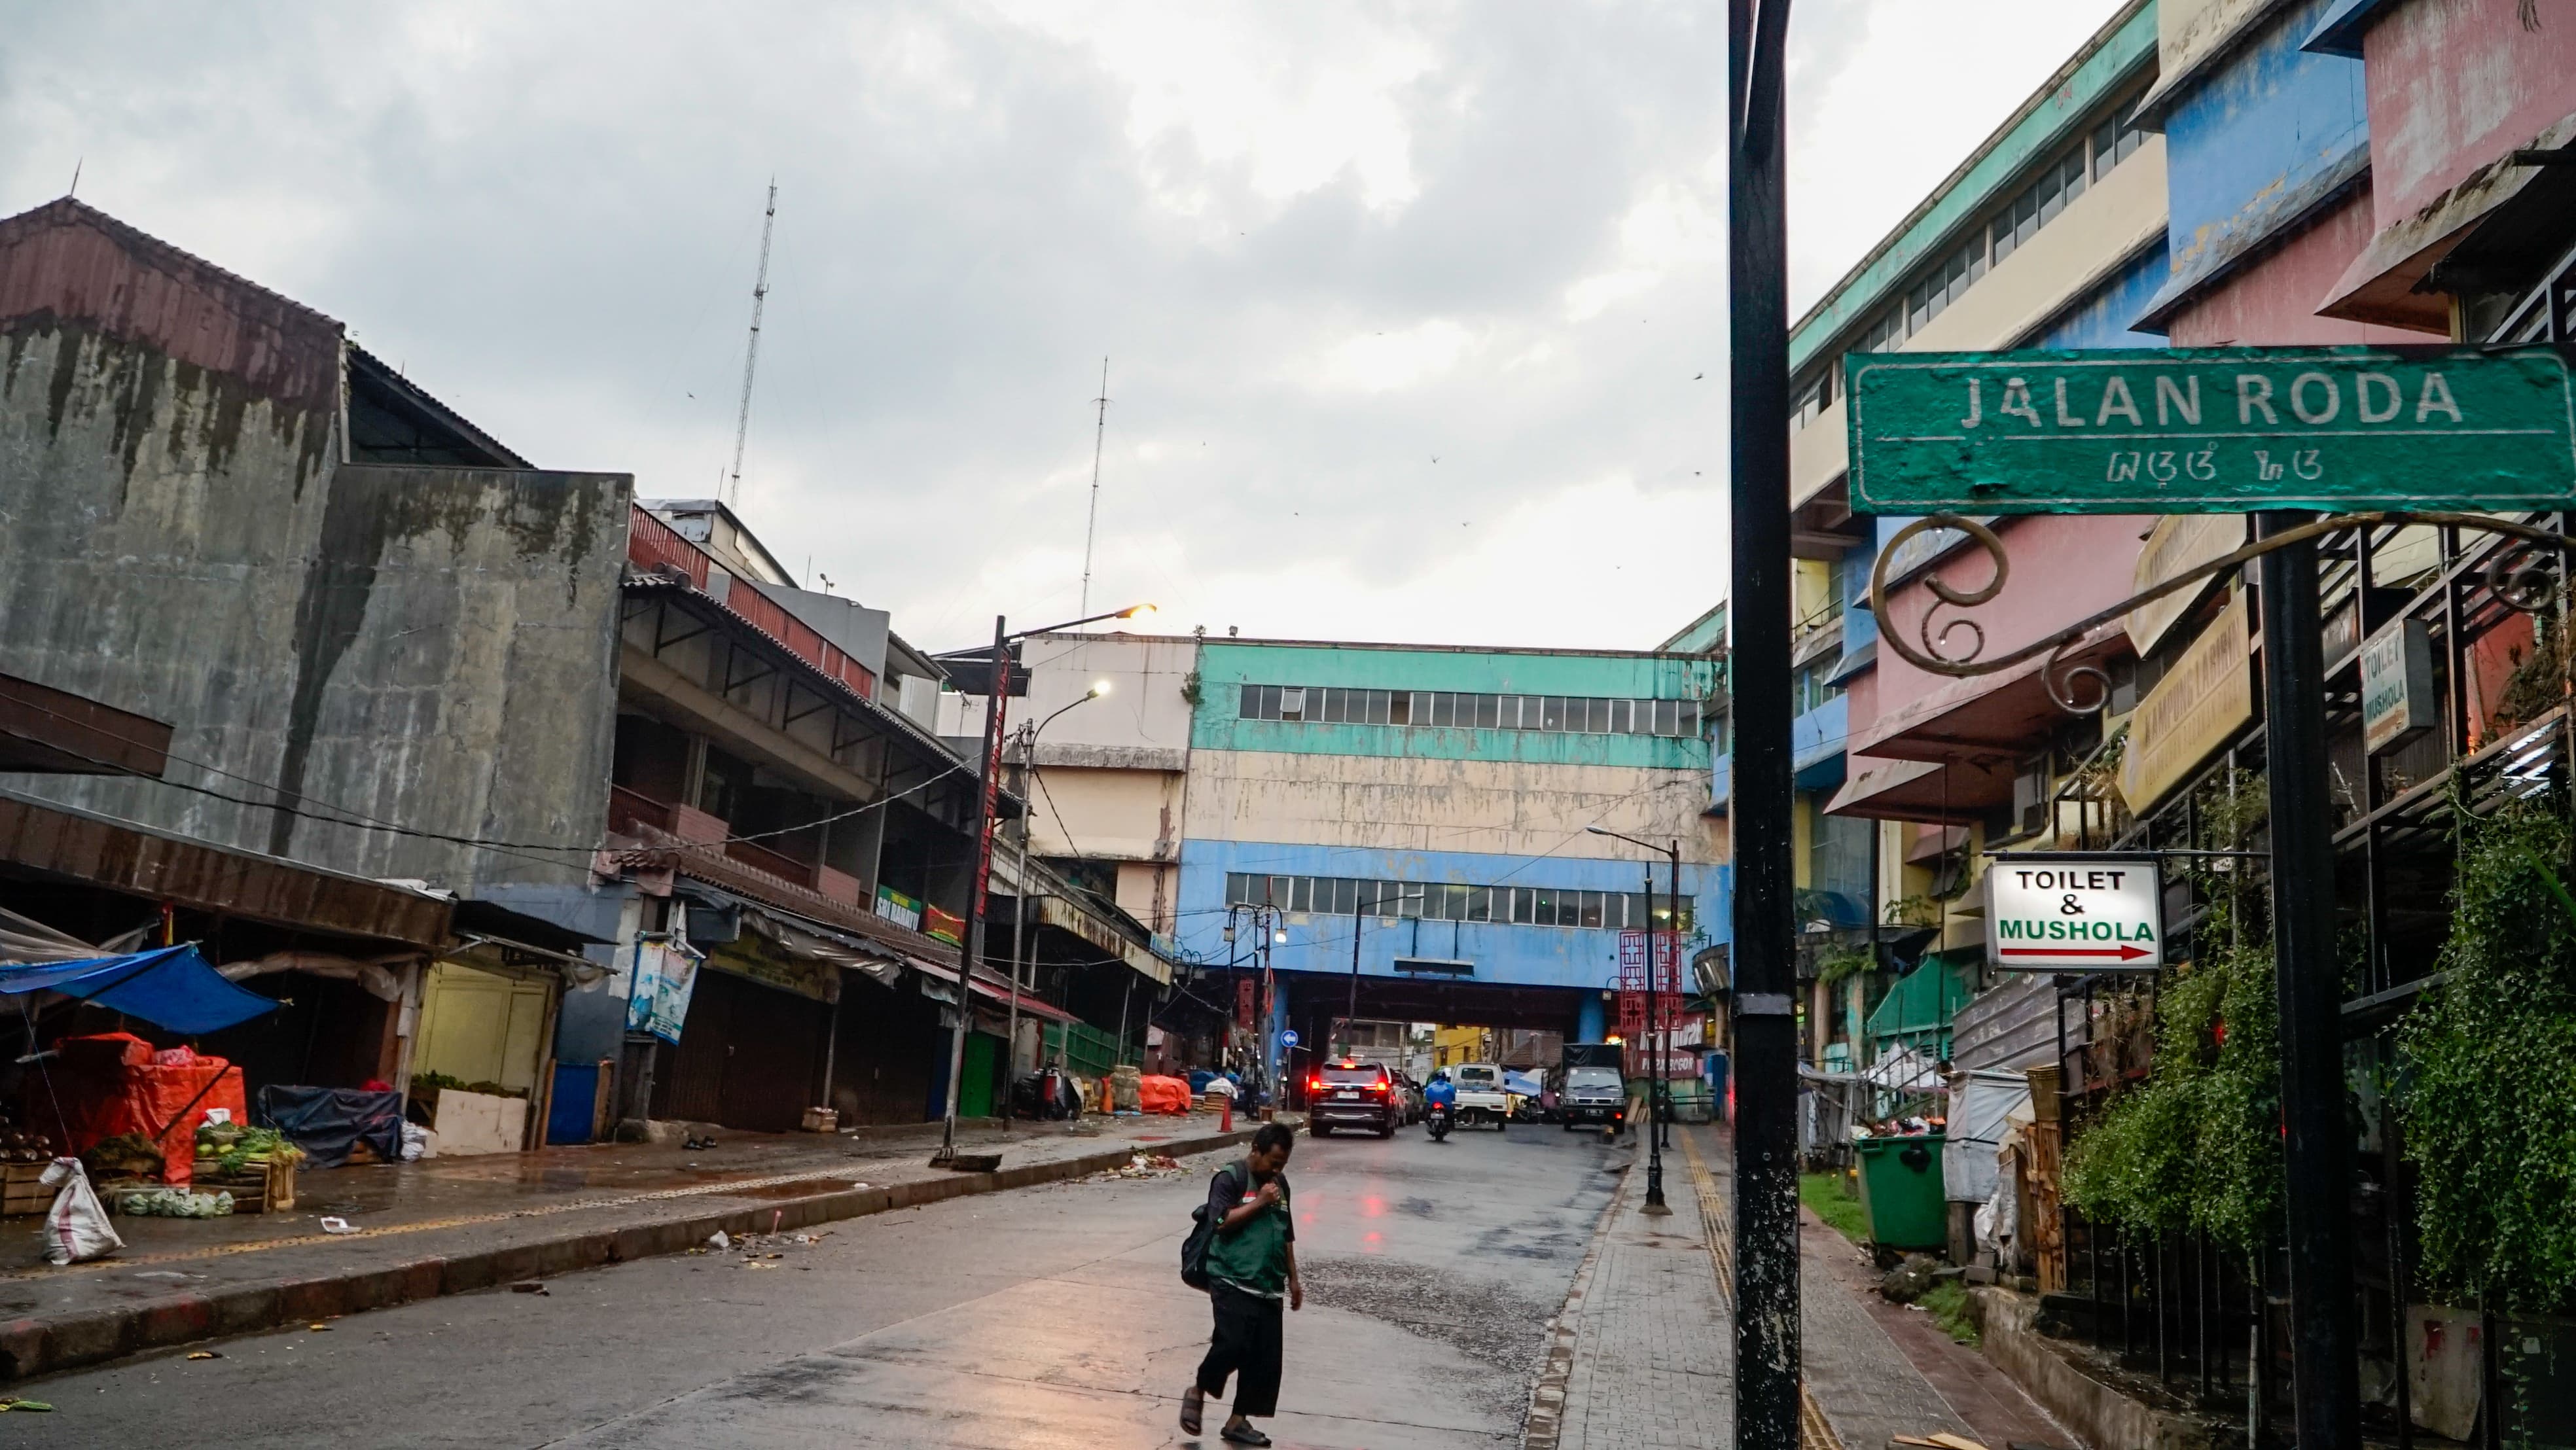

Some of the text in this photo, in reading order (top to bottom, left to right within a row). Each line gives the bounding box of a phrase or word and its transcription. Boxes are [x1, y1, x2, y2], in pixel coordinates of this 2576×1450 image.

[1961, 371, 2463, 429] JALAN RODA
[2365, 636, 2399, 682] TOILET
[2145, 668, 2194, 746] KAMPUNG
[2366, 679, 2405, 724] MUSHOLA
[2016, 871, 2126, 890] TOILET
[876, 896, 891, 920] SRI
[2060, 894, 2085, 915] &
[1999, 919, 2156, 942] MUSHOLA
